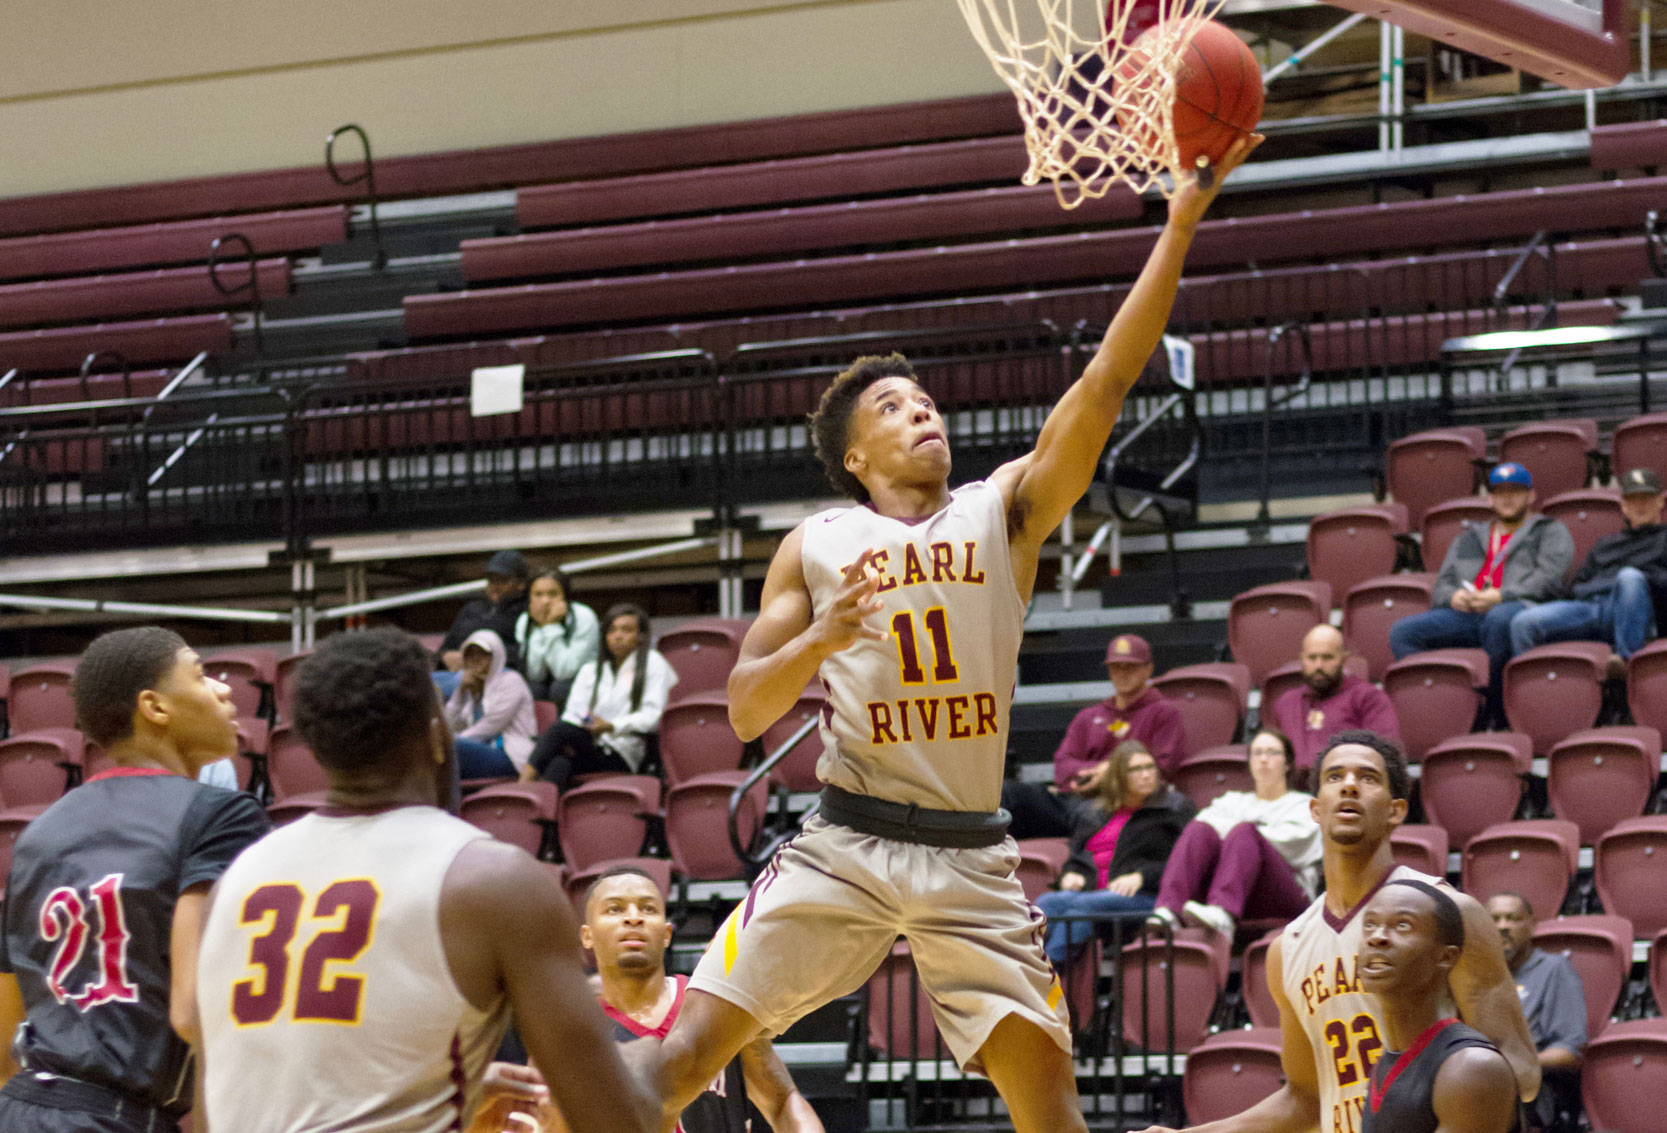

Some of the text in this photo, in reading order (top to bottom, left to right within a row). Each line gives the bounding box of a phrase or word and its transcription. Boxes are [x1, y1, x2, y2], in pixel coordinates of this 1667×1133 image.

[890, 605, 960, 686] 11
[866, 691, 999, 745] RIVER
[40, 873, 139, 1013] 21
[230, 876, 382, 1029] 32
[1324, 1012, 1383, 1088] 22
